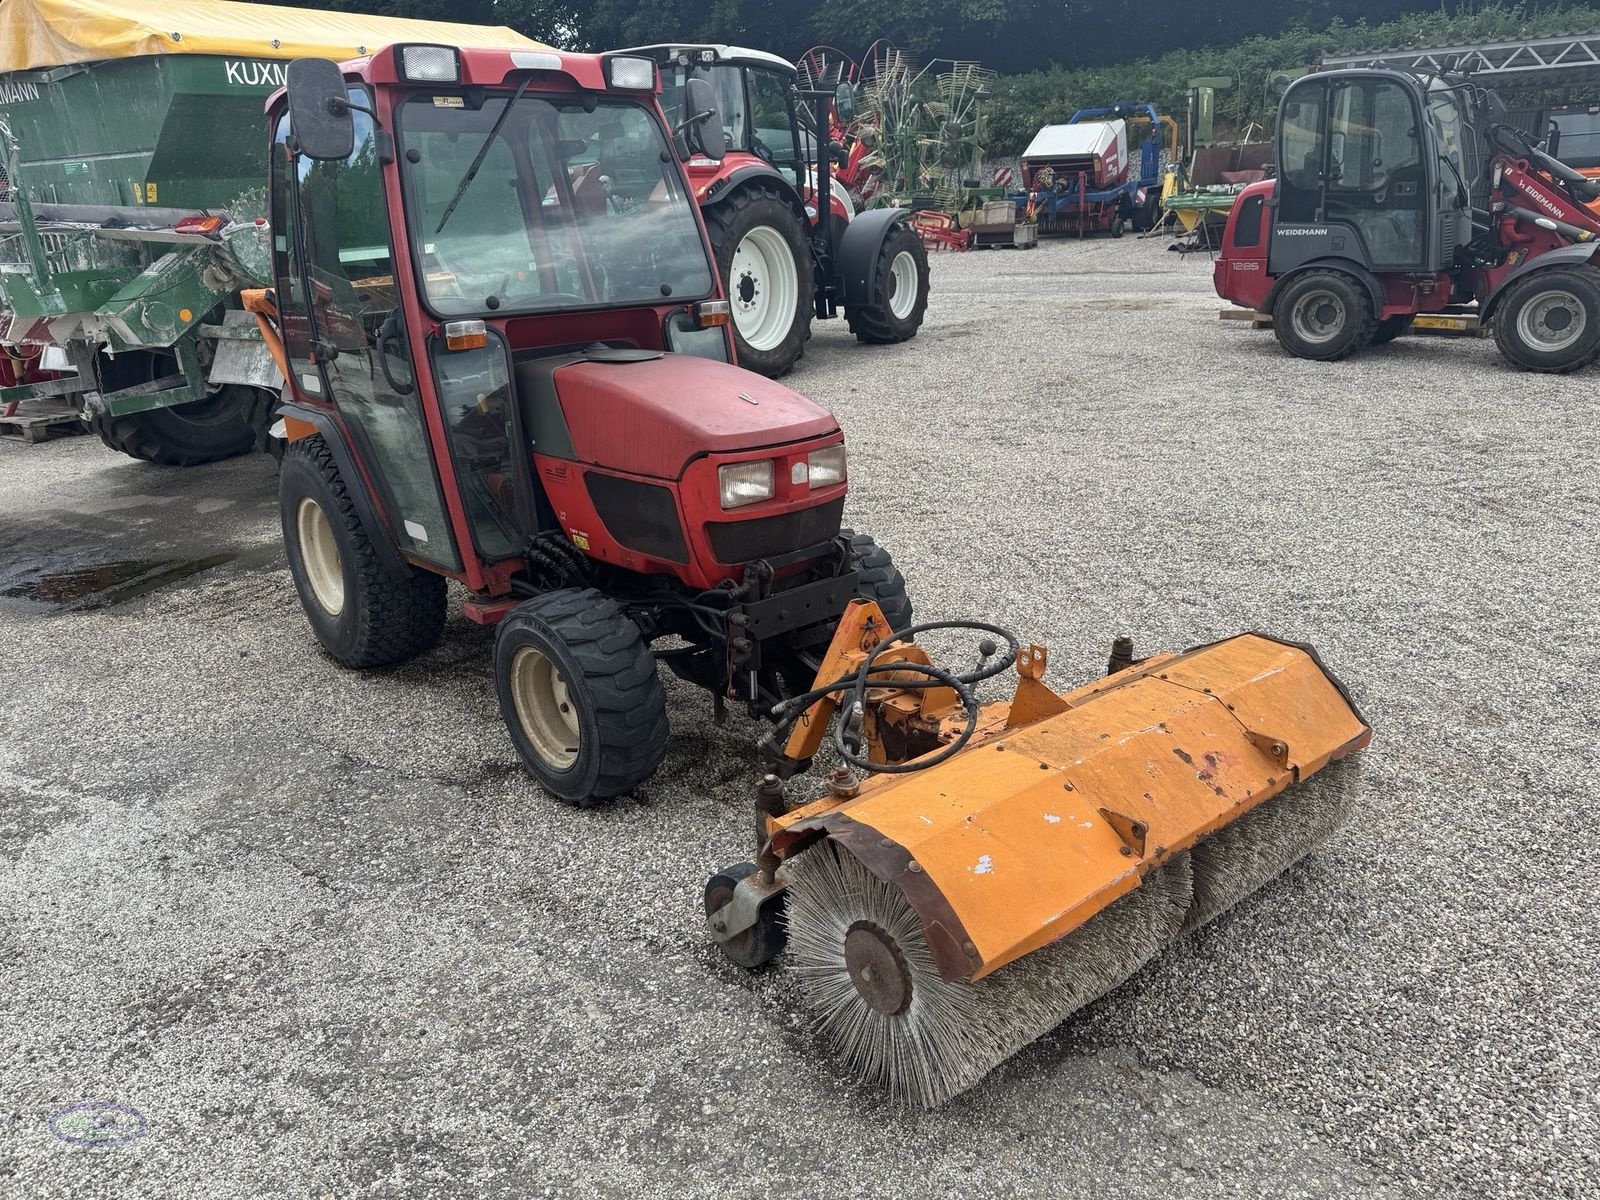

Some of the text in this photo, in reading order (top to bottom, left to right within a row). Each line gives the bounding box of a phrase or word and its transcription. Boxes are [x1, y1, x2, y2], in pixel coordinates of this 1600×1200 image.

[225, 61, 289, 86] KUXM
[0, 81, 39, 104] MANN
[1232, 262, 1260, 270] 1285
